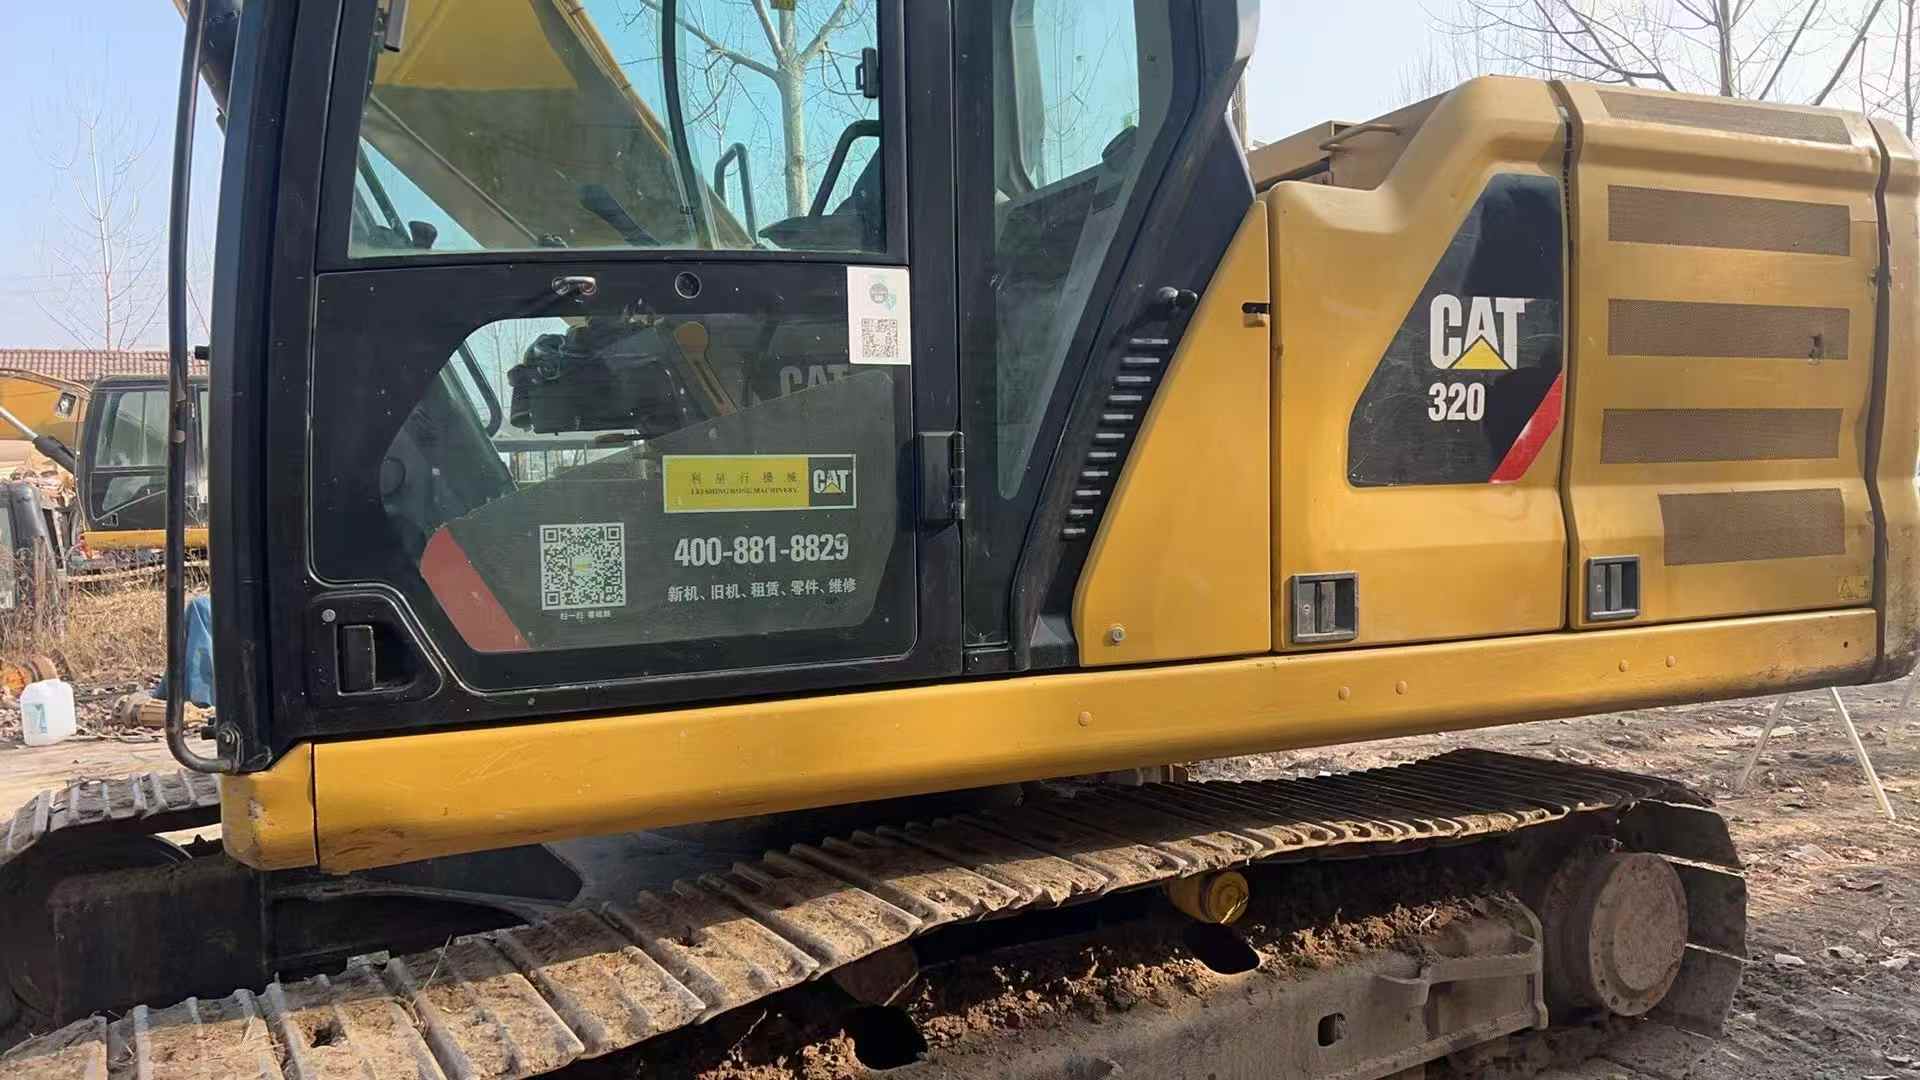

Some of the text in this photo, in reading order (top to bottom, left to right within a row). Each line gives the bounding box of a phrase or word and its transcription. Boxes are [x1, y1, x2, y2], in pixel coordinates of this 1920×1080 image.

[1430, 294, 1526, 370] CAT
[1428, 382, 1486, 422] 320
[812, 469, 850, 494] CAT
[674, 533, 850, 567] 400-881-8829
